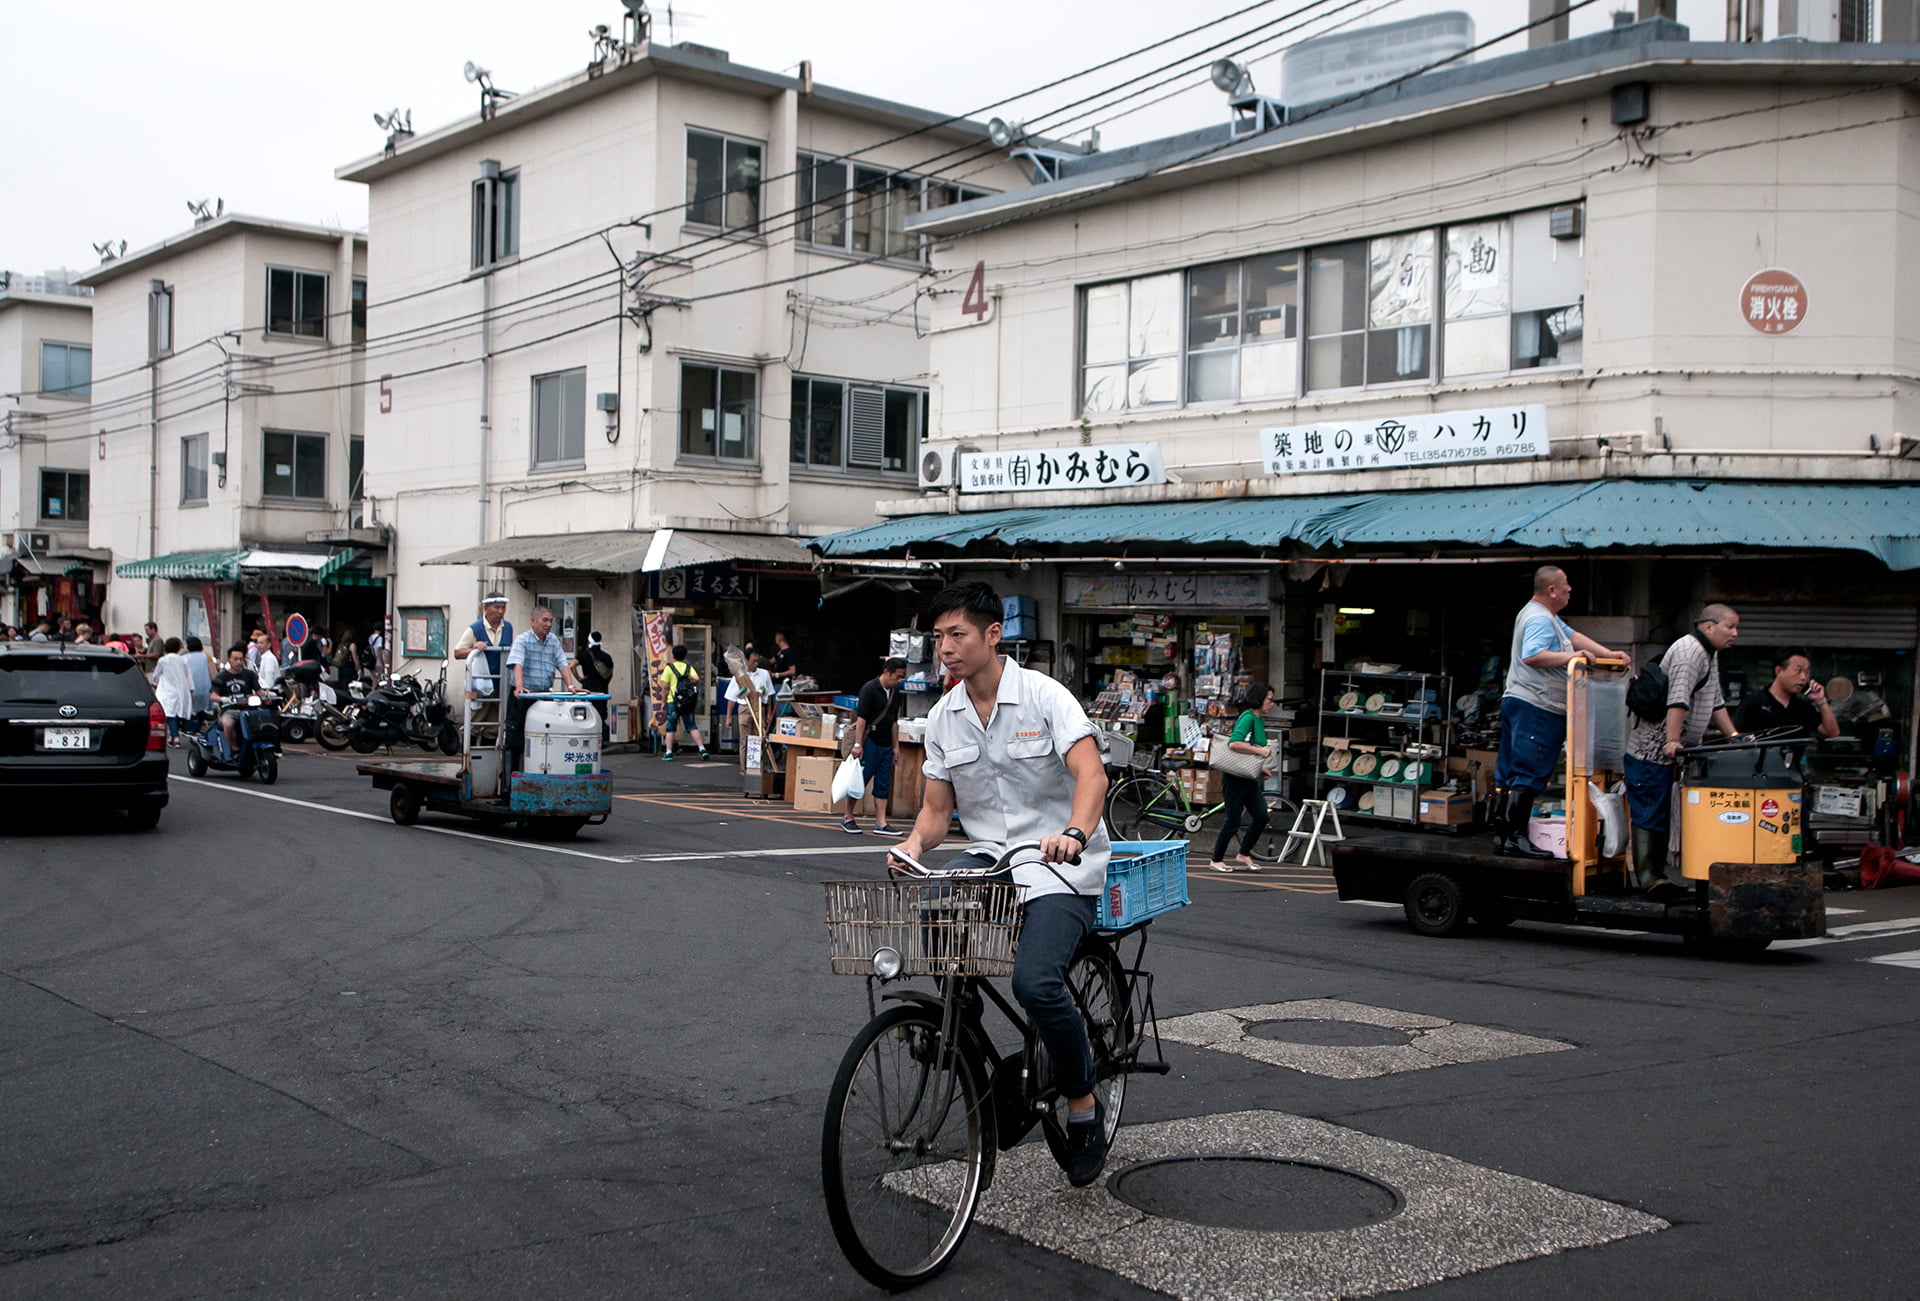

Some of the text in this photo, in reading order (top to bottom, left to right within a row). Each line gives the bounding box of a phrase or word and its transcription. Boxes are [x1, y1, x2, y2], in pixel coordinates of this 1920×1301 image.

[962, 260, 988, 321] 4
[1750, 296, 1798, 320] 消火栓
[380, 373, 392, 414] 5
[1274, 429, 1354, 457] 築地の
[1433, 411, 1528, 442] ハカリ
[1130, 577, 1196, 602] かみむら
[1109, 883, 1123, 918] VANS
